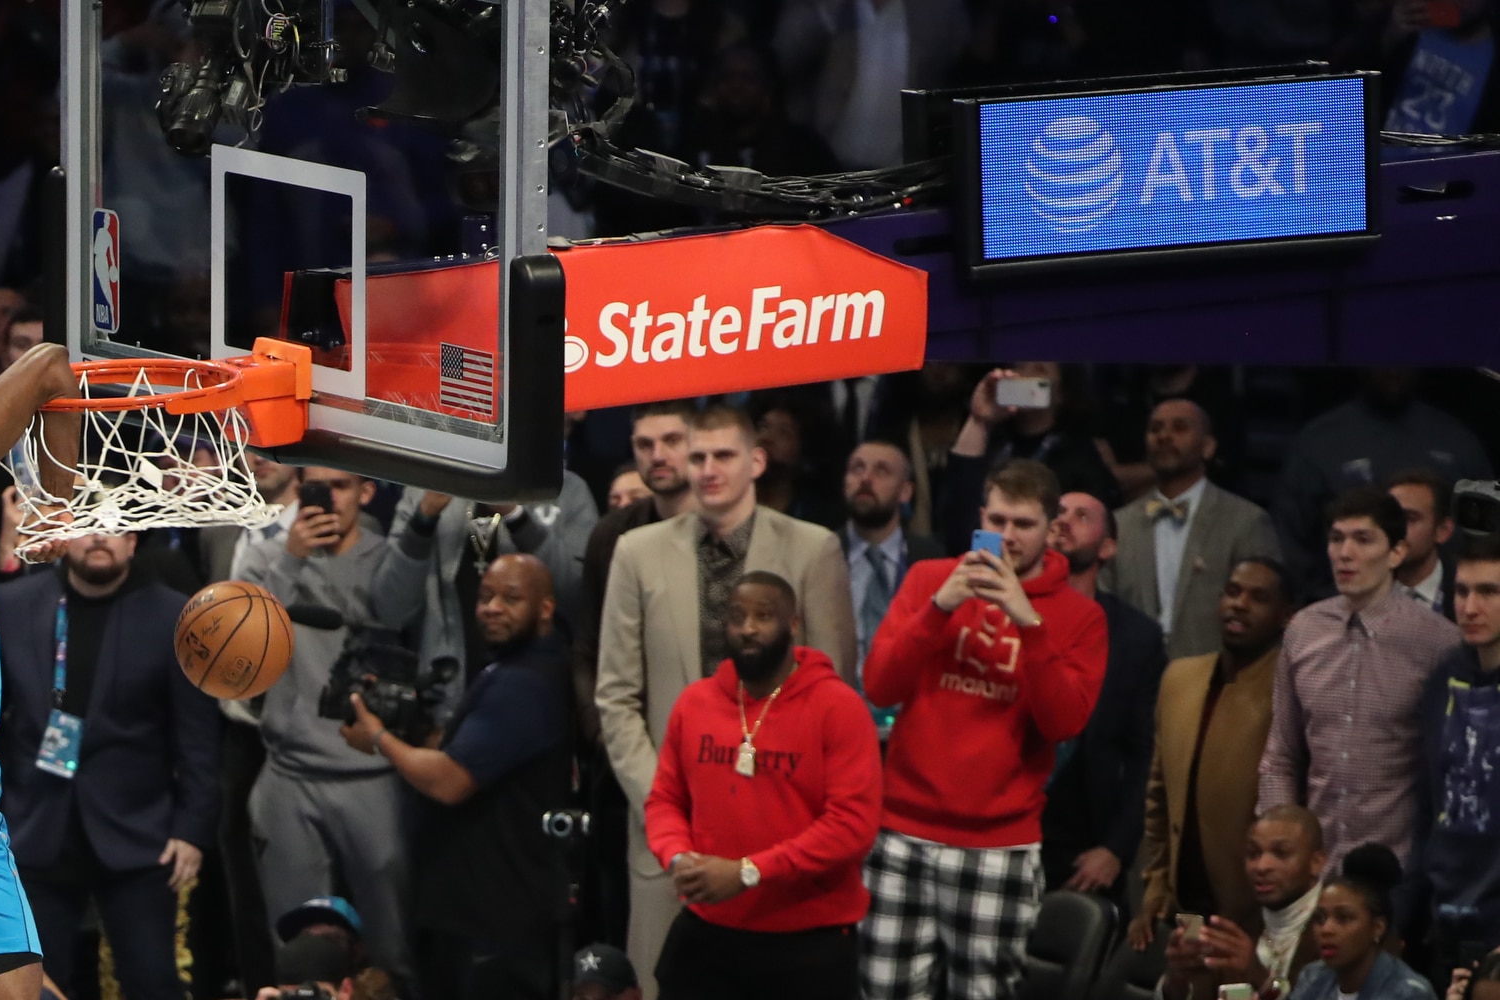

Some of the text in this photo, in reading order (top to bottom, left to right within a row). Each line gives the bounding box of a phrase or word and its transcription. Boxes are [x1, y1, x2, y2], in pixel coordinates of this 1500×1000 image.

[1140, 122, 1323, 205] AT&T
[96, 303, 110, 324] NBA
[697, 733, 802, 778] Burrry
